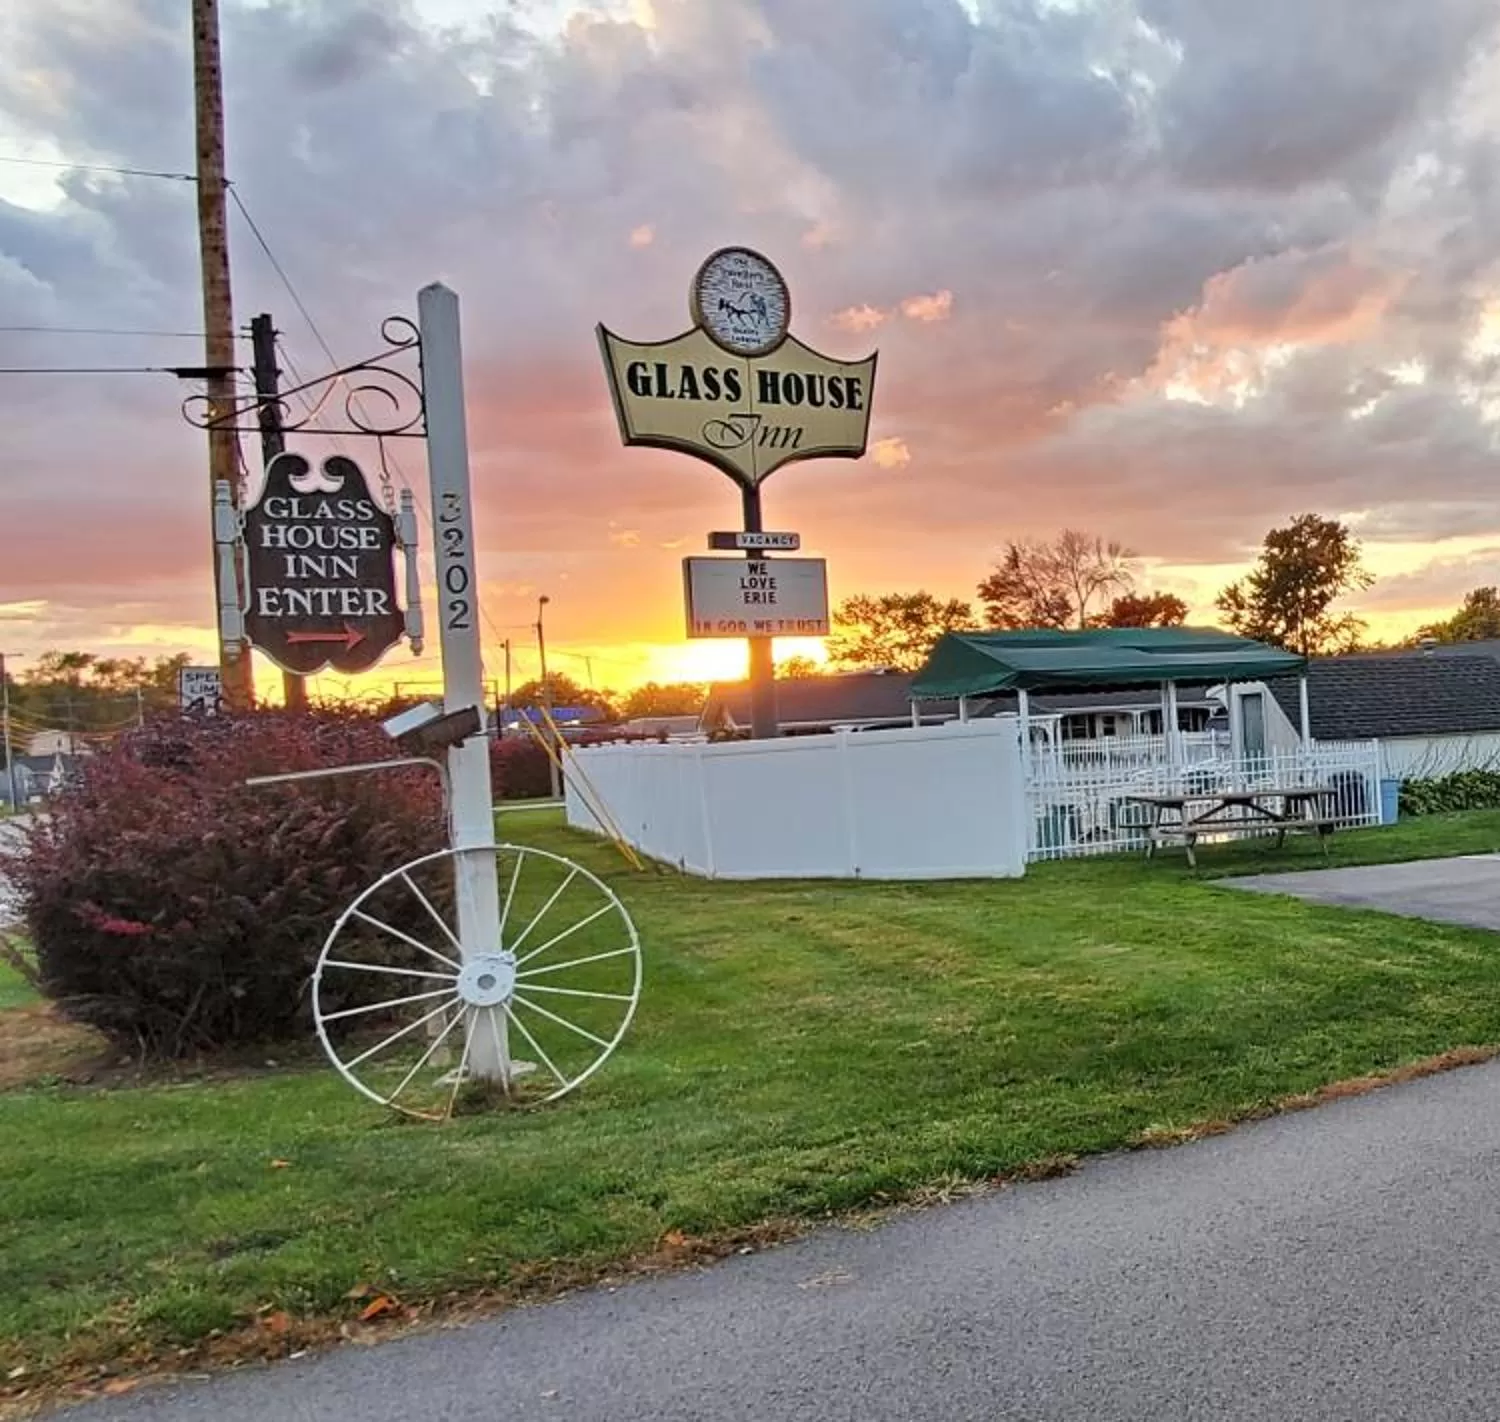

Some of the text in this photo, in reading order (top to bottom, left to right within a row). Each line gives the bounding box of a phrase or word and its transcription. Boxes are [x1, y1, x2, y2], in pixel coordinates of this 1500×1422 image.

[626, 361, 863, 411] GLASS HOUSE
[702, 413, 804, 449] Inn
[263, 496, 375, 521] GLASS
[260, 524, 382, 549] HOUSE
[741, 535, 795, 546] VACANCY
[285, 554, 359, 579] INN
[439, 492, 470, 630] 3202
[748, 562, 768, 575] WE
[740, 577, 778, 590] LOVE
[256, 586, 393, 617] ENTER
[743, 591, 778, 605] ERIE
[696, 619, 823, 633] IN GOD WE TRUST
[185, 672, 219, 682] SPE
[189, 683, 219, 694] LIM
